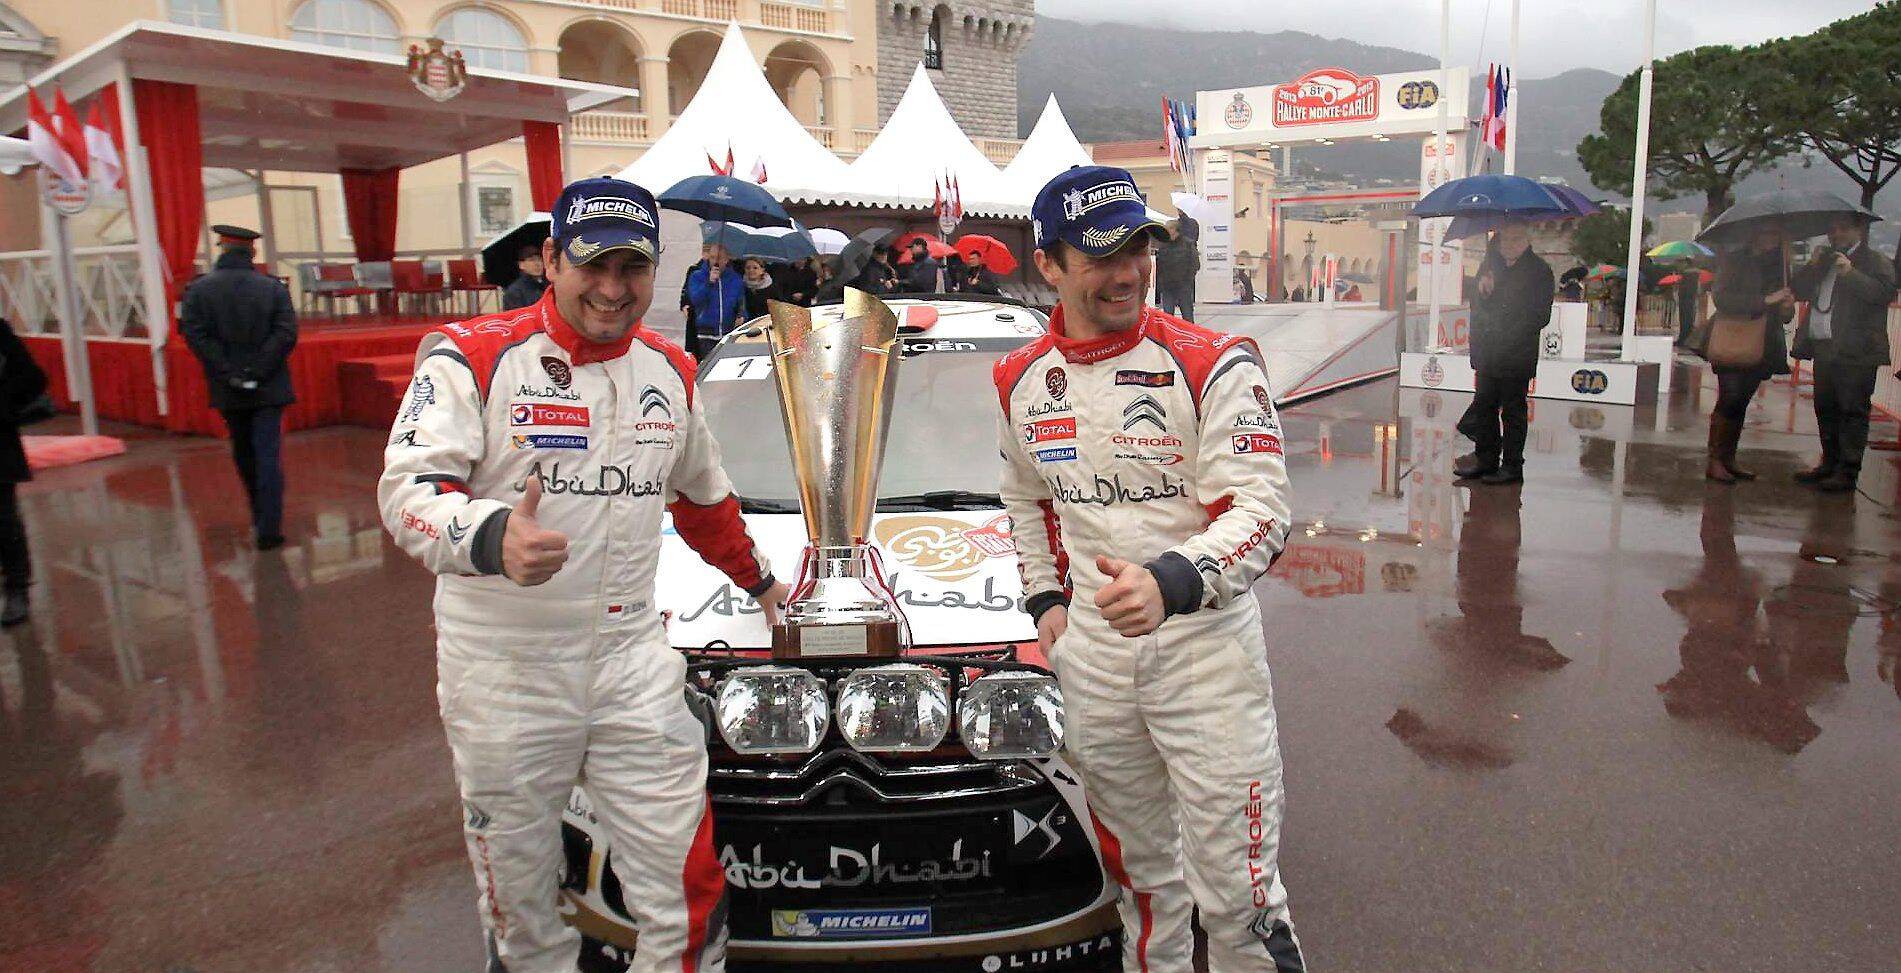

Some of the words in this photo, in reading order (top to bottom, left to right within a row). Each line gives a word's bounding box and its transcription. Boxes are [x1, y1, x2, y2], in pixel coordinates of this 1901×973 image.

[1276, 100, 1308, 122] RALLYE
[534, 408, 587, 422] TOTAL
[1036, 424, 1075, 437] TOTAL
[536, 436, 586, 447] MICHELIN
[1094, 471, 1190, 506] Dhabi
[718, 842, 821, 890] Abu
[824, 838, 993, 886] Dhabi
[819, 912, 928, 929] MICHELIN
[1009, 936, 1112, 968] LUHTA
